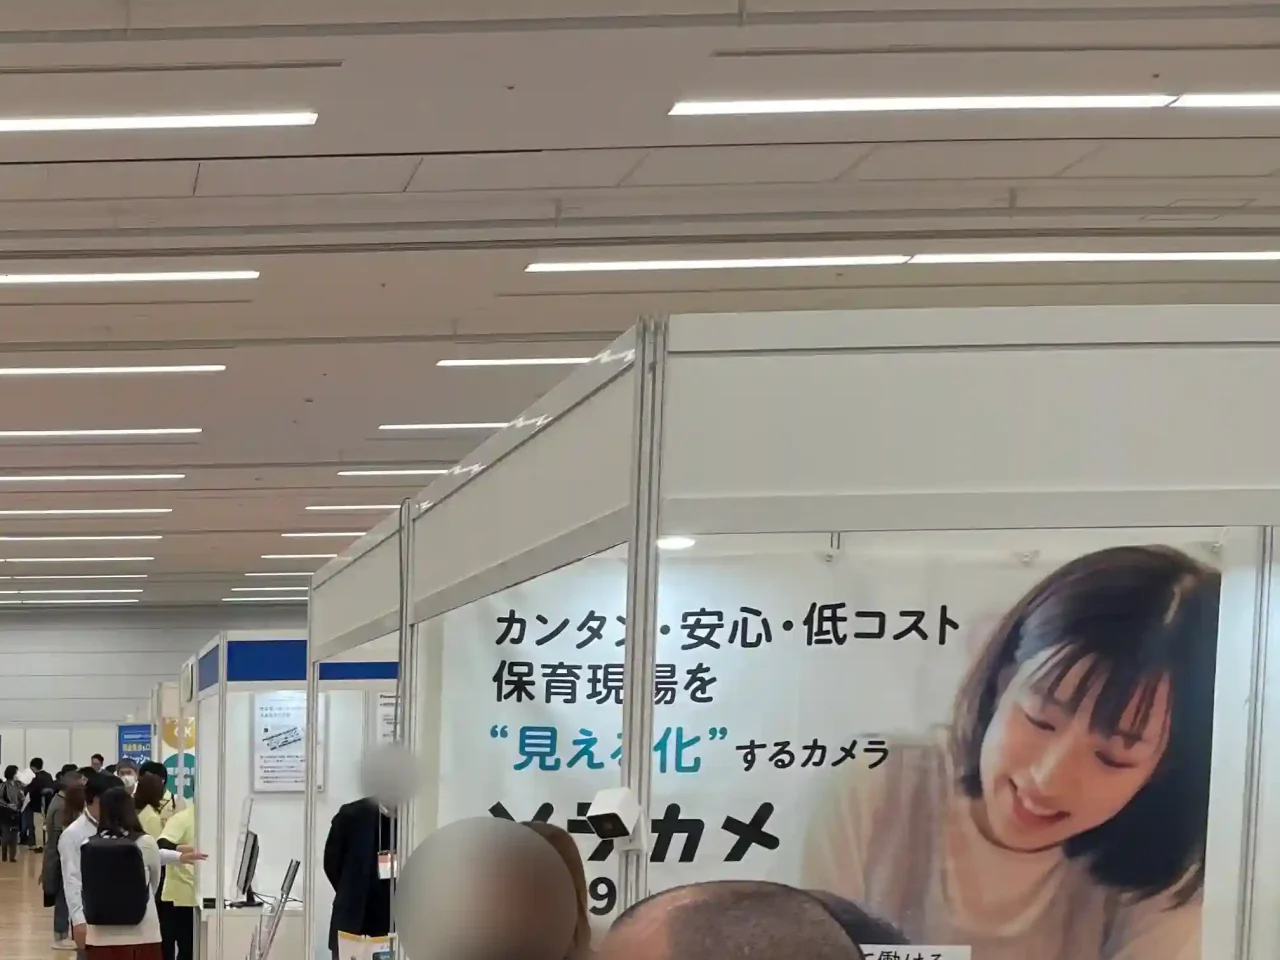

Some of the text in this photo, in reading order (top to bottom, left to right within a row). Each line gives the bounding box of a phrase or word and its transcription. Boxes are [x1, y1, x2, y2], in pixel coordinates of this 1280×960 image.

[494, 601, 961, 651] カンタ・安心・低コスト
